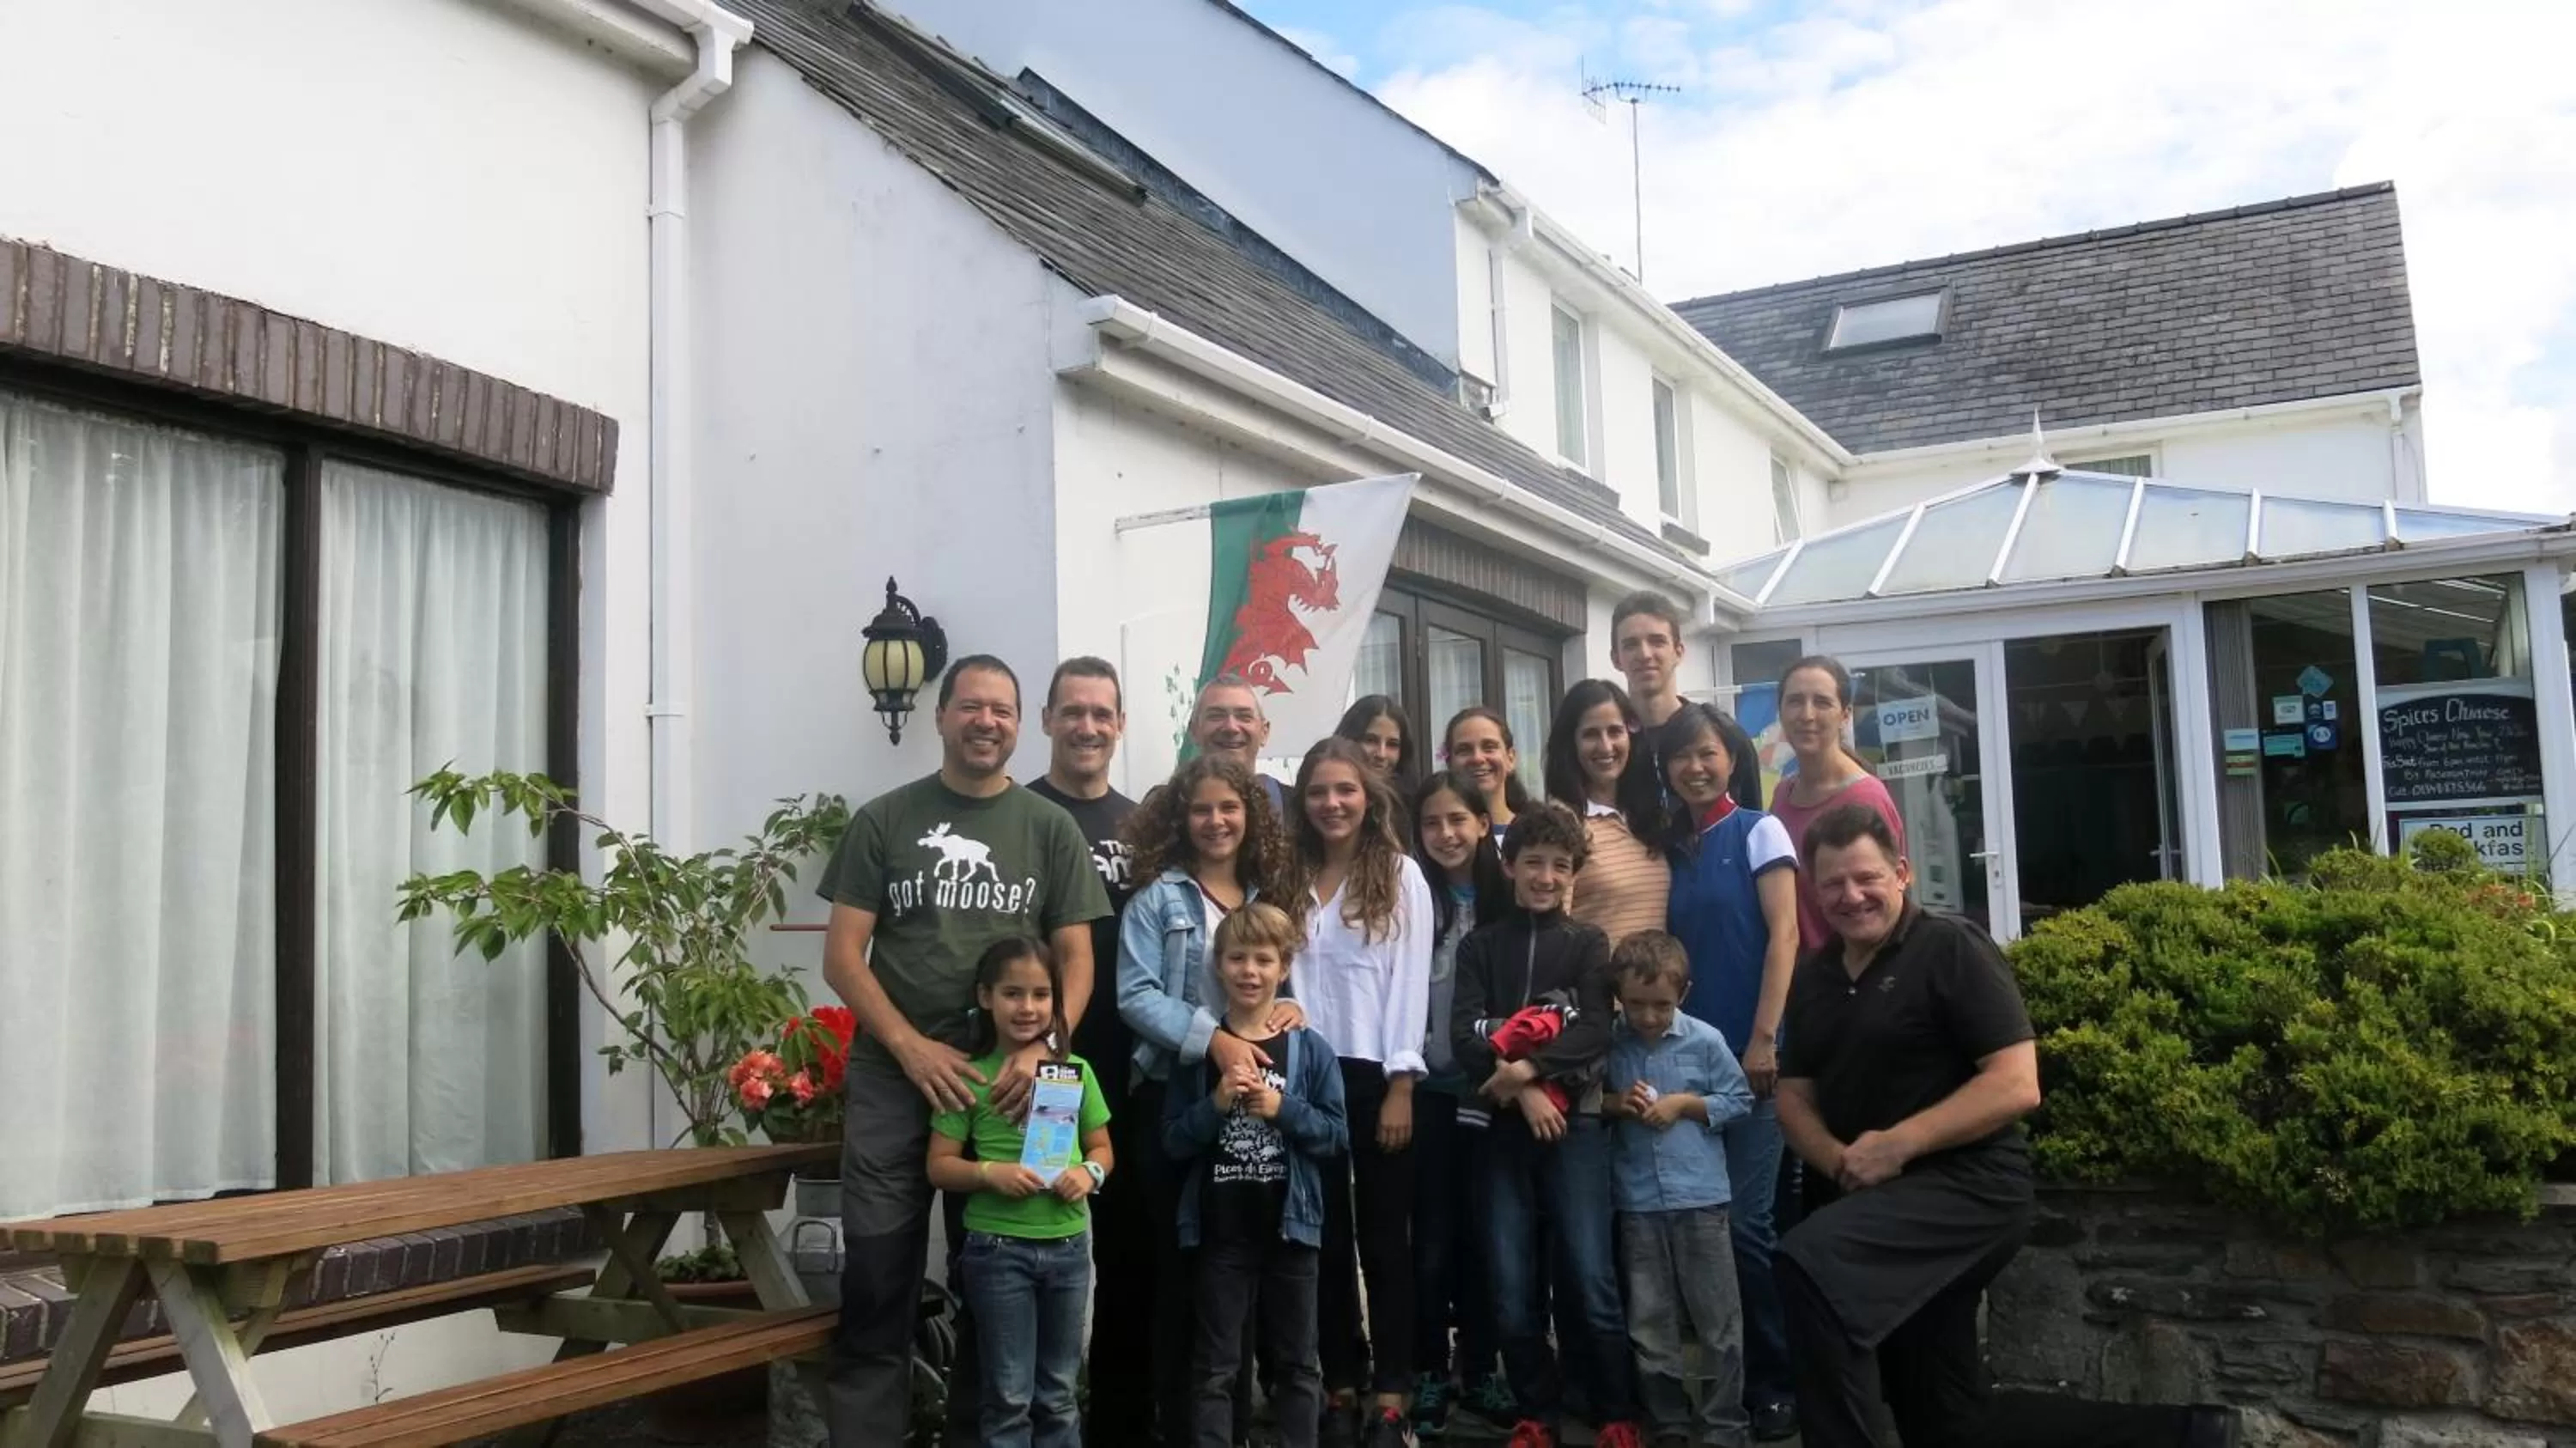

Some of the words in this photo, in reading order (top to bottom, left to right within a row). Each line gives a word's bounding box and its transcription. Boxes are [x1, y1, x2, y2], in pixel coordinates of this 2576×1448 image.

[1883, 707, 1930, 727] OPEN
[2482, 820, 2523, 838] and
[889, 870, 924, 917] got
[936, 877, 1036, 915] moose?
